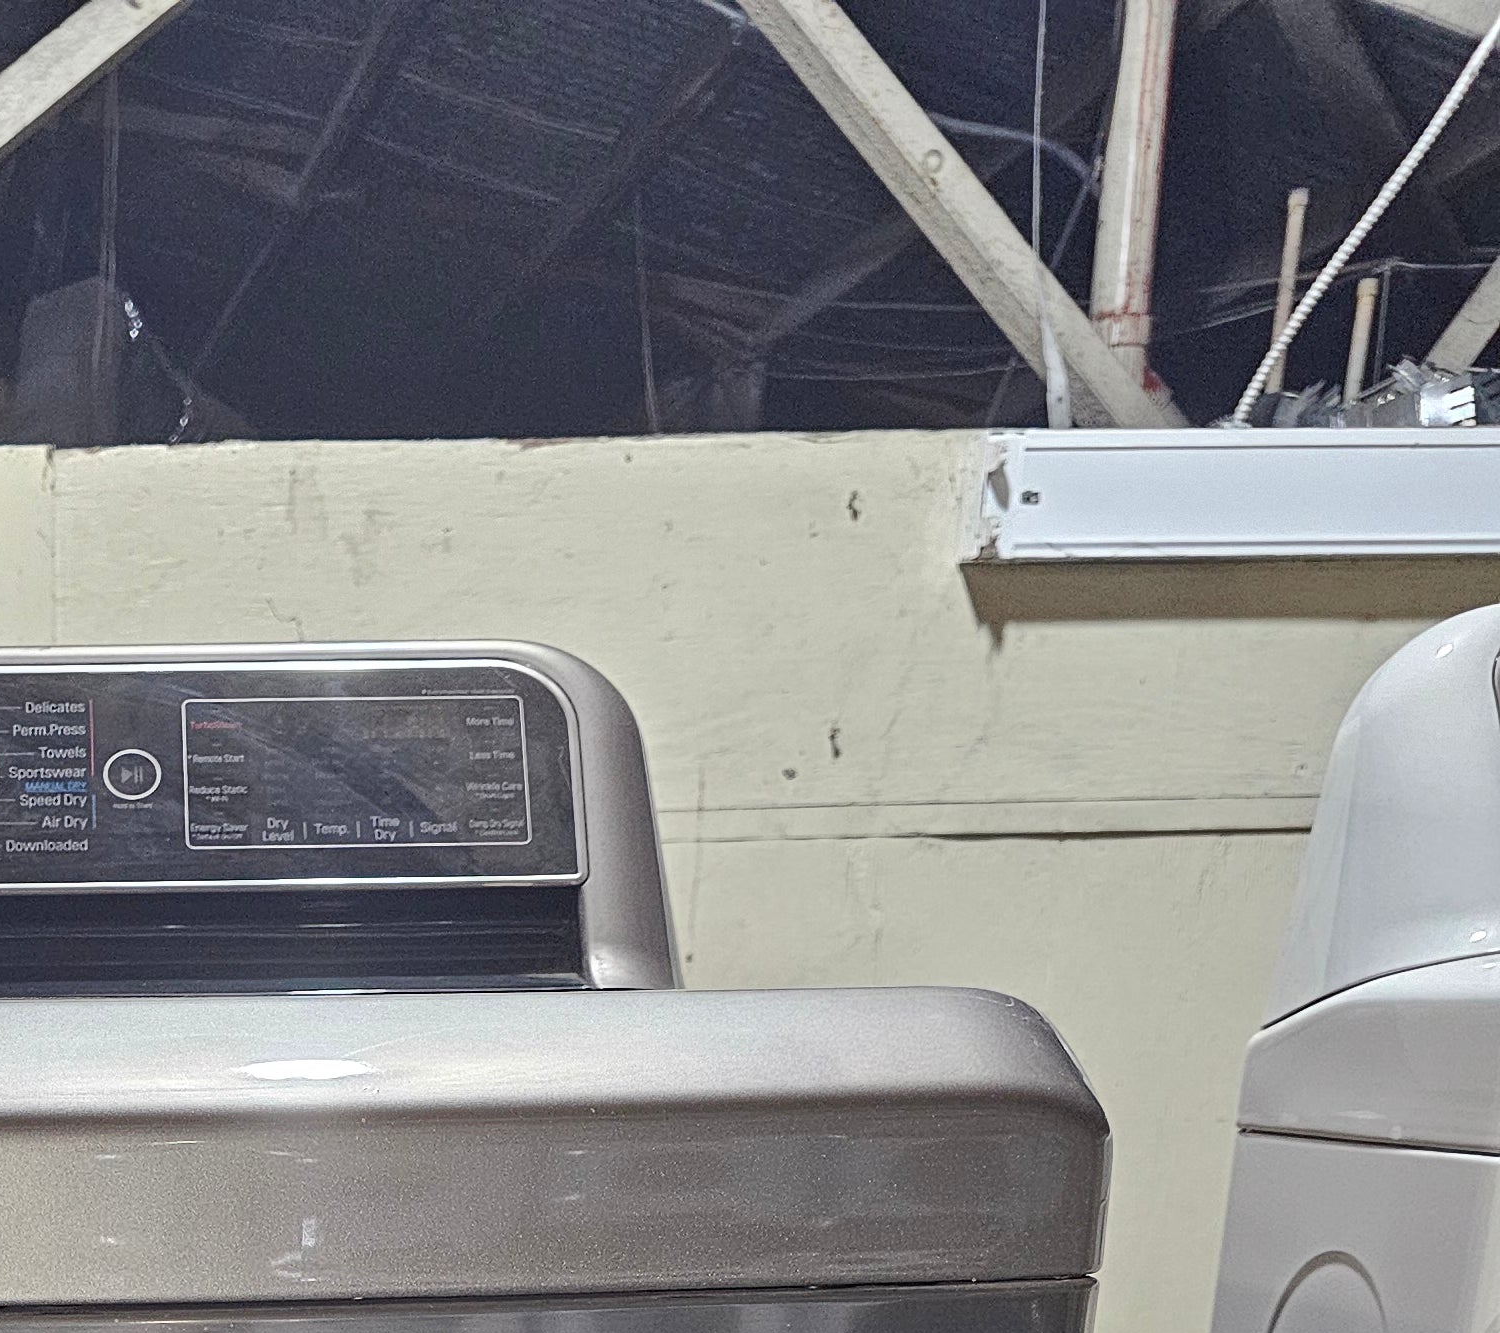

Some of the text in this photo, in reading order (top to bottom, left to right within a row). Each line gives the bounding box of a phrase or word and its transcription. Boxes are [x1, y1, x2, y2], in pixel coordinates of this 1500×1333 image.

[25, 701, 86, 713] Delicates
[38, 746, 87, 759] Towels
[8, 766, 87, 781] Sportswear
[19, 794, 88, 808] Speed Dry
[41, 816, 88, 830] Air Dry
[266, 817, 289, 831] Dry
[370, 816, 400, 828] Time
[419, 821, 459, 835] Signal
[313, 822, 350, 836] Temp.
[374, 829, 397, 842] Dry
[261, 831, 295, 842] Level
[5, 839, 89, 852] Downloaded
